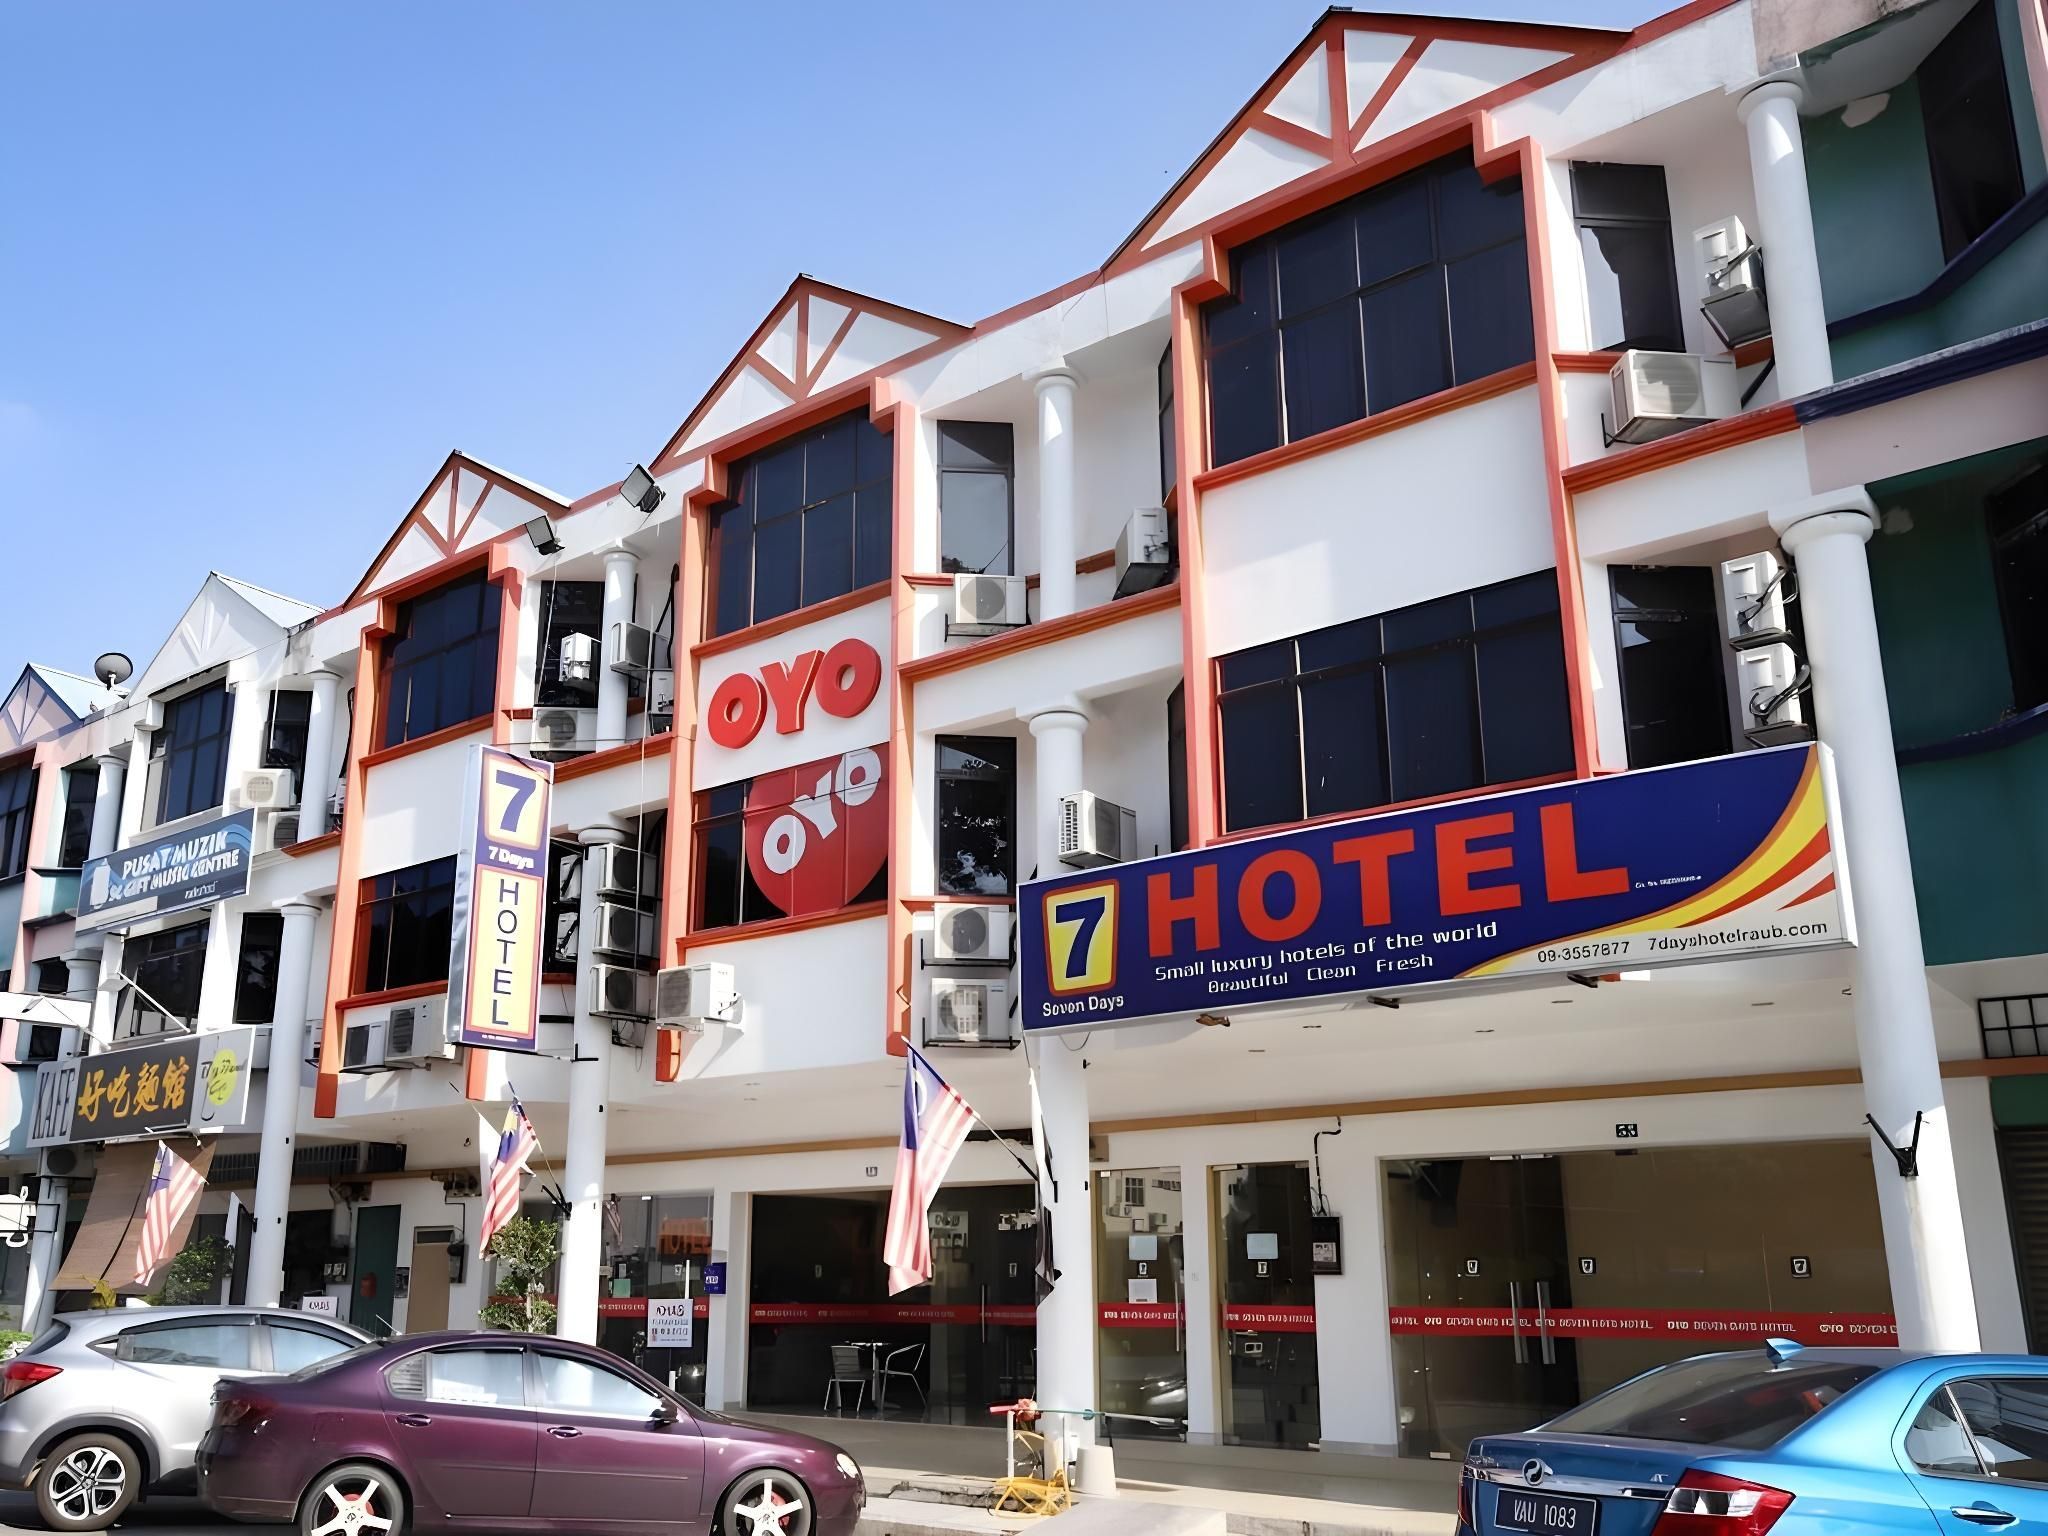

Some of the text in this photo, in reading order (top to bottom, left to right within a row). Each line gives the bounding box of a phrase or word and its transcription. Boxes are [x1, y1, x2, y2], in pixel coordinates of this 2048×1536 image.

[708, 638, 881, 748] OYO
[496, 770, 536, 832] 7
[763, 748, 881, 874] OYO
[171, 831, 228, 865] MUZIK
[488, 846, 534, 869] 7 Days
[150, 864, 189, 890] MUSIC
[1055, 802, 1630, 979] 7 HOTEL
[492, 879, 519, 1025] HOTEL
[1155, 921, 1497, 981] Small luxury hotels of the world
[1648, 922, 1828, 951] 7dayshotelraub.com
[1208, 953, 1433, 993] Beautiful Clean Fresh
[1043, 995, 1124, 1017] Seven Days
[32, 1068, 75, 1140] KAFE
[1514, 1499, 1577, 1529] VAU 1083
